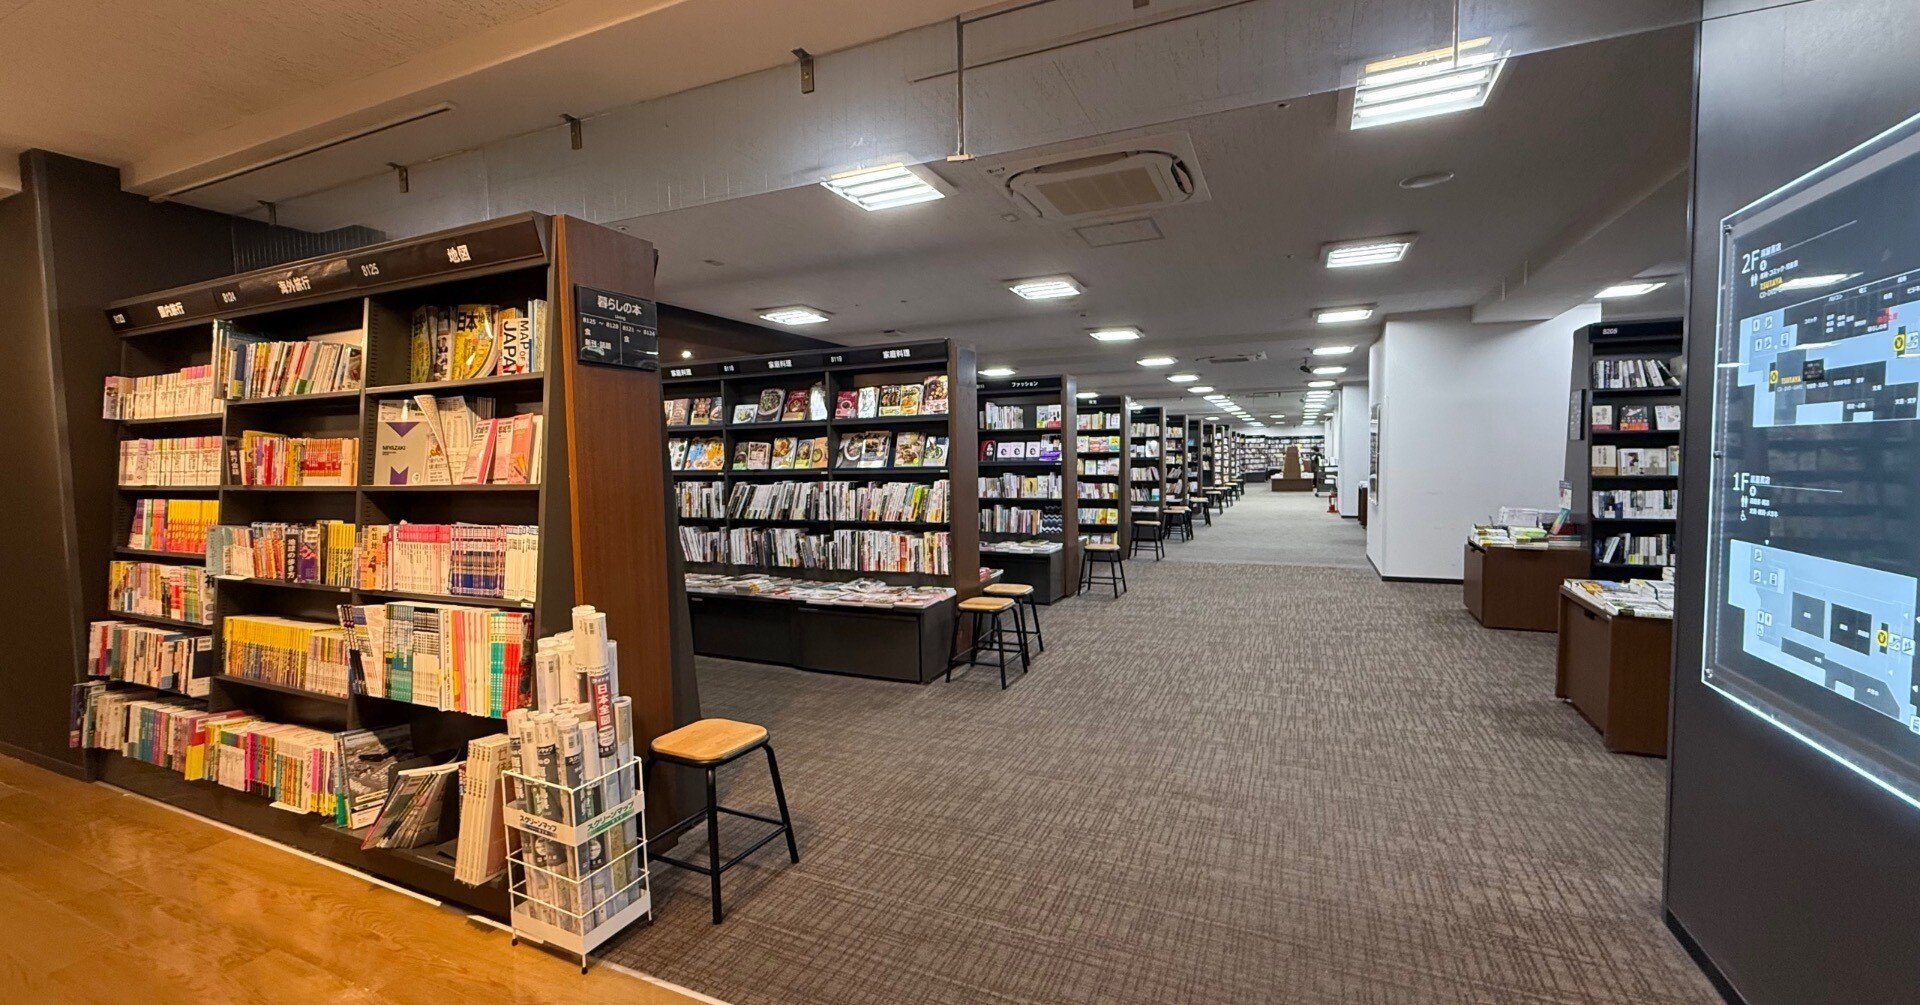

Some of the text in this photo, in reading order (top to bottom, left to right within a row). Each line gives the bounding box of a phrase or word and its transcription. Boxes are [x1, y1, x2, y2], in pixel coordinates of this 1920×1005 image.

[446, 244, 472, 264] 地図
[1741, 249, 1760, 274] 2F
[361, 262, 379, 277] 8125
[278, 276, 311, 295] 海外旅行
[597, 295, 642, 316] 暮らしの本
[520, 320, 529, 349] MAP
[882, 349, 911, 359] 家庭料理
[1732, 472, 1750, 491] 1F
[287, 538, 296, 579] 地球の歩き方
[519, 815, 557, 832] スクリーンマップ
[587, 801, 634, 832] スクリーンマップ
